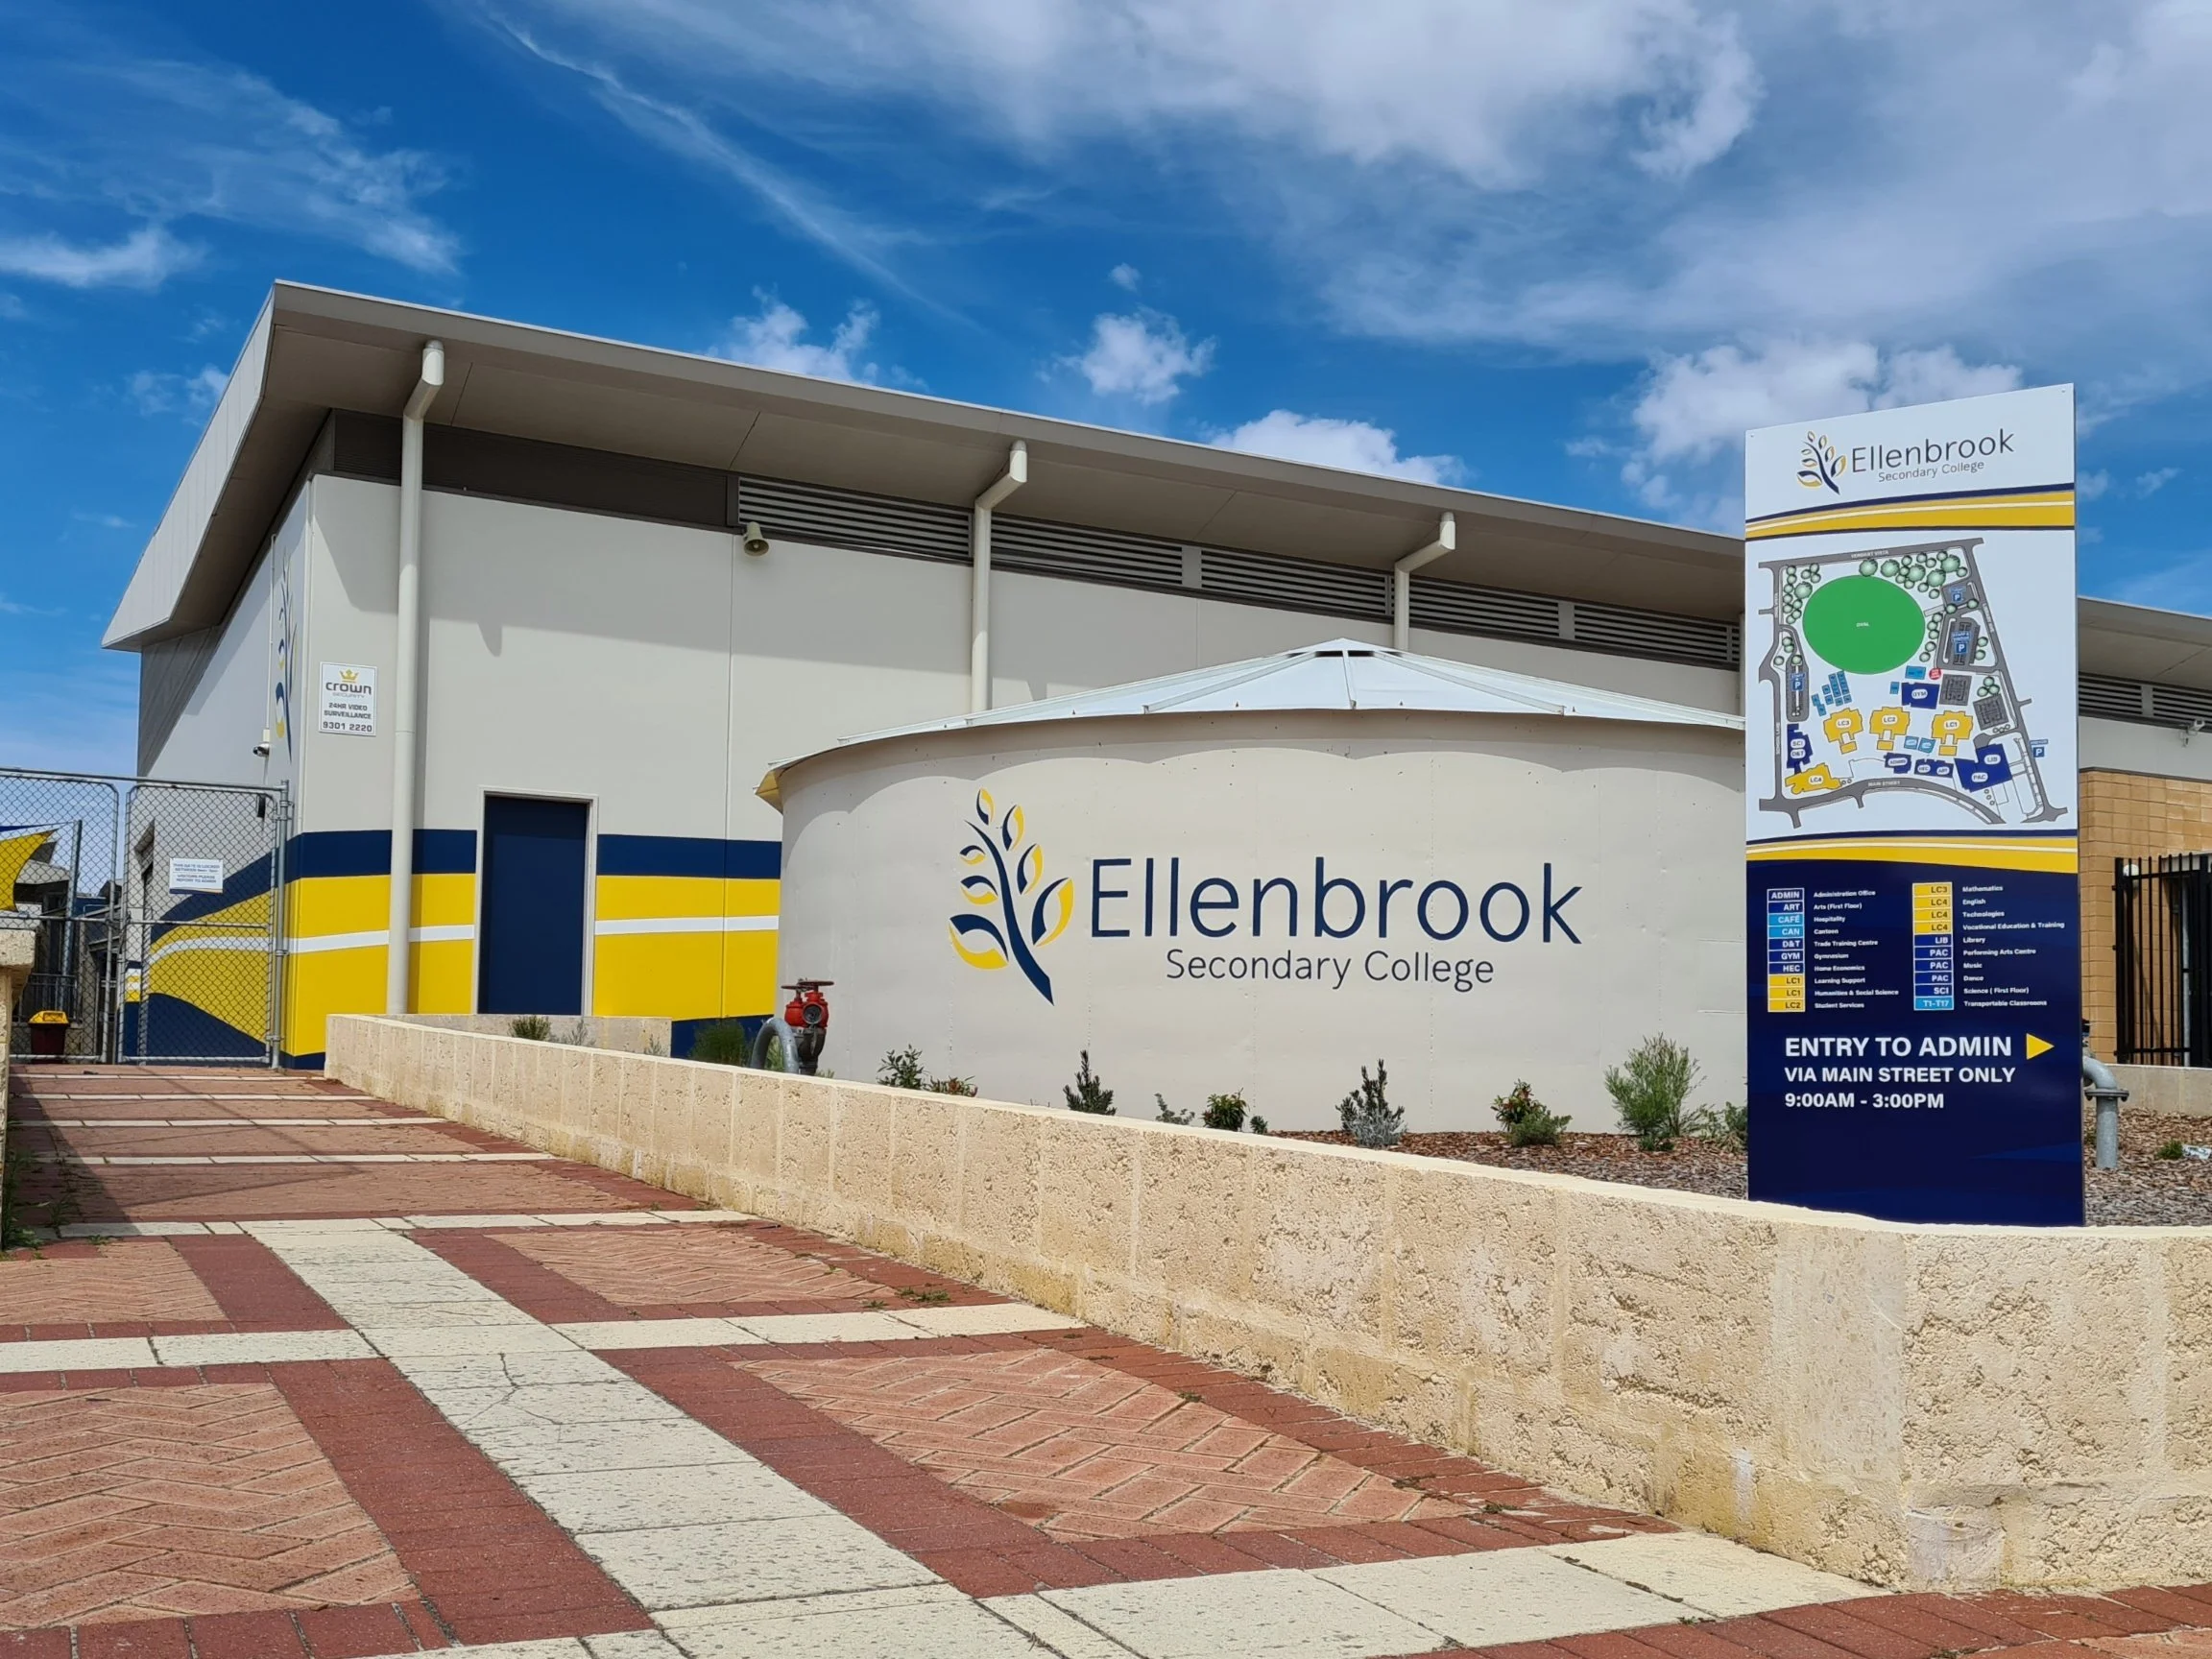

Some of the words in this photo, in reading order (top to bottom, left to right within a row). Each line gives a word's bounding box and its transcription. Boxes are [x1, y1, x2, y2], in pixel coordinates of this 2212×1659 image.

[1852, 428, 2014, 472] Ellenbrook
[1878, 468, 1938, 483] Secondary
[1942, 461, 1984, 473] College
[325, 683, 372, 695] crown
[324, 710, 372, 720] SURVEILLANCE
[323, 721, 346, 730] 9301
[349, 723, 373, 733] 2220
[1091, 856, 1583, 945] Ellenbrook
[1771, 891, 1800, 899] ADMIN
[1166, 949, 1352, 990] Secondary
[1363, 950, 1495, 993] College
[1785, 1037, 1870, 1057] ENTRY
[1875, 1037, 1912, 1057] TO
[1918, 1036, 2012, 1057] ADMIN
[1784, 1067, 1817, 1082] VIA
[1822, 1067, 1872, 1082] MAIN
[1878, 1067, 1954, 1082] STREET
[1959, 1067, 2016, 1083] ONLY
[1785, 1093, 1855, 1108] 9:00AM
[1872, 1094, 1944, 1109] 3:00PM
